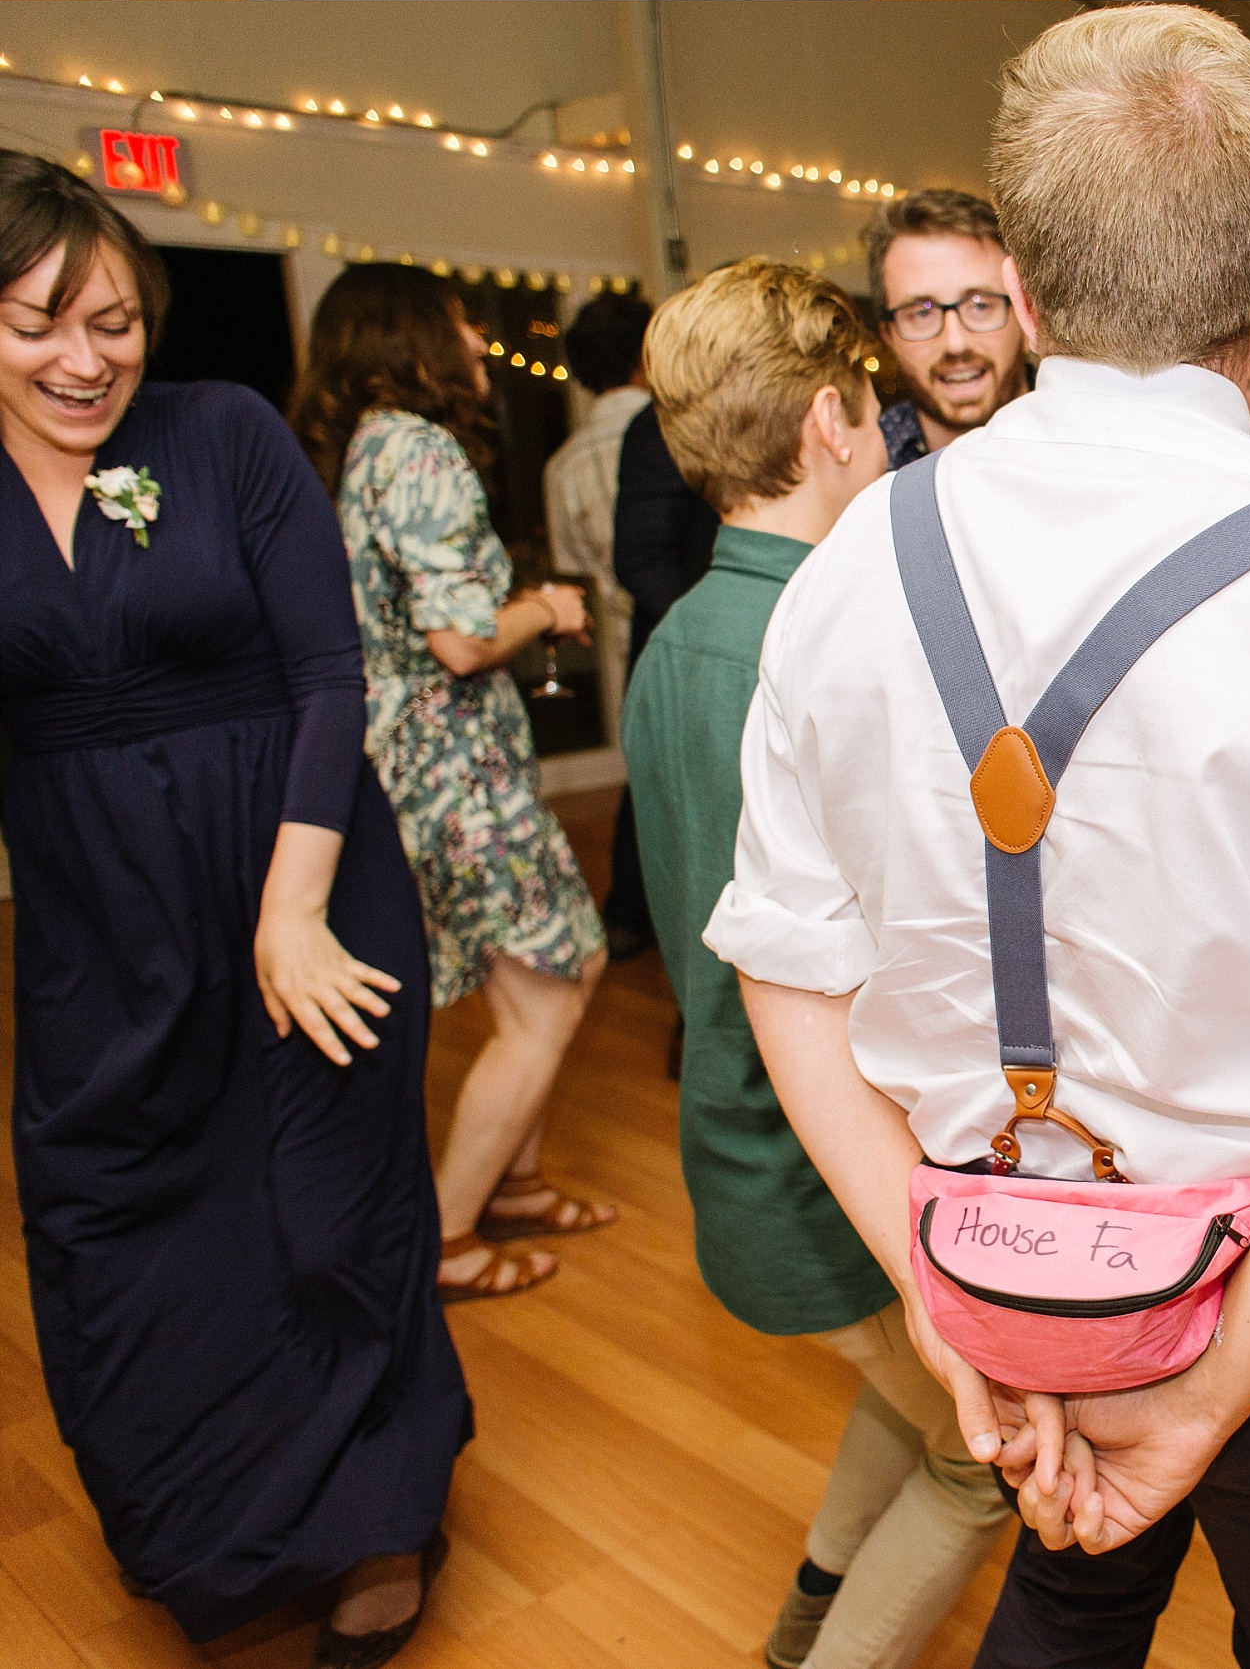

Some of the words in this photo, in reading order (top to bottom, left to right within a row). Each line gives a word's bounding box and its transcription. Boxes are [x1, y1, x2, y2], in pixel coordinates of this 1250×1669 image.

[100, 128, 180, 193] EXIT
[953, 1206, 1059, 1256] House
[1090, 1220, 1139, 1271] Fa
